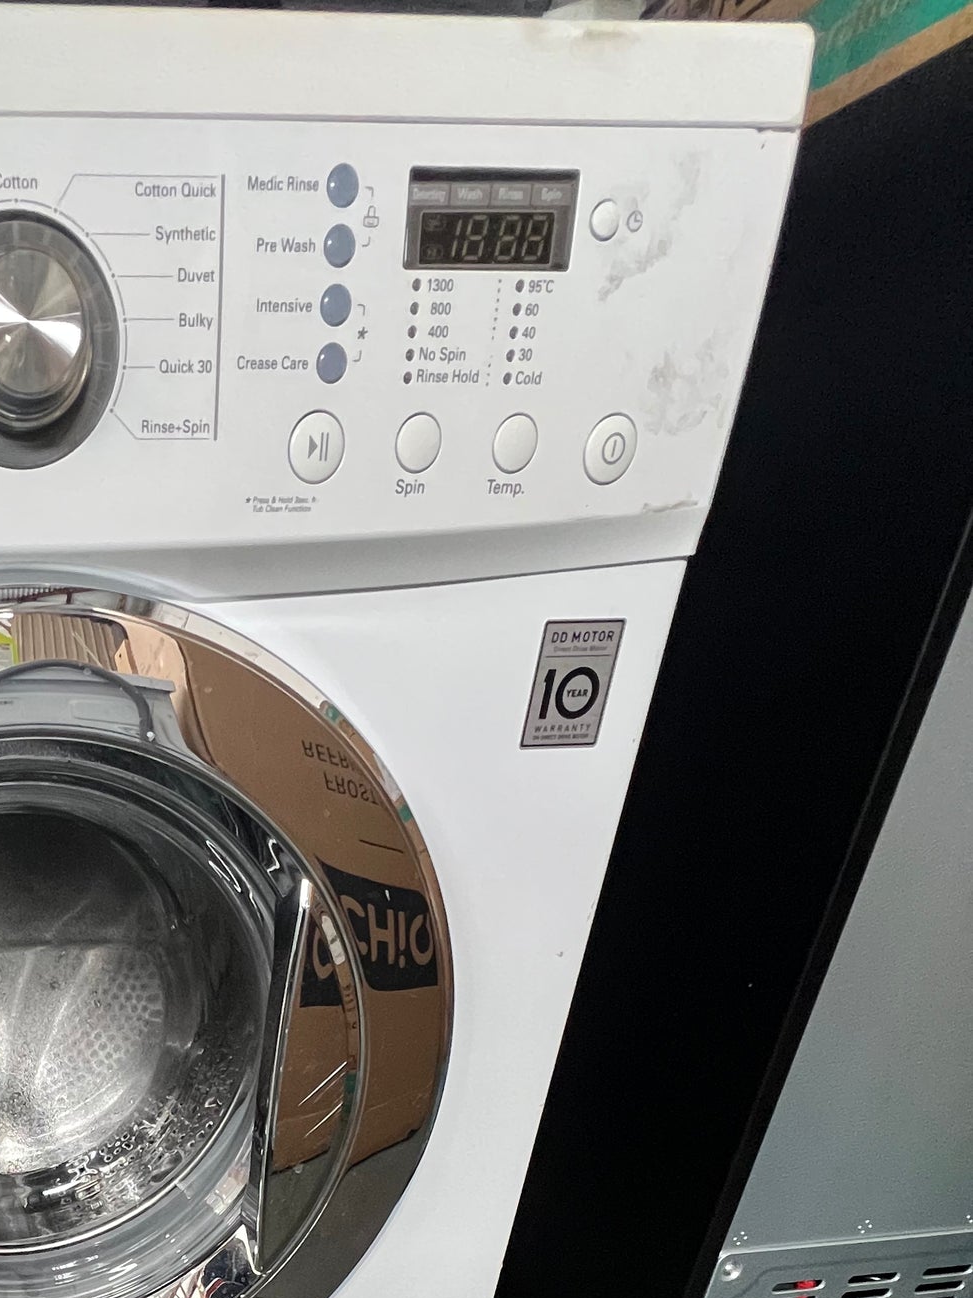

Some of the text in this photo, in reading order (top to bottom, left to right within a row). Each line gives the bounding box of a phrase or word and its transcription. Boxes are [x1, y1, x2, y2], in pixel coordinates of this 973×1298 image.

[135, 181, 216, 198] Cotton Quick
[247, 175, 319, 191] Medic Rinse
[155, 225, 216, 245] Synthetic
[256, 237, 316, 252] Pre Wash
[177, 267, 215, 282] Duvet
[427, 278, 454, 292] 1300
[528, 279, 554, 293] 95°C
[256, 298, 312, 313] Intensive
[430, 302, 452, 315] 800
[525, 303, 539, 316] 60
[178, 312, 214, 331] Bulky
[428, 325, 449, 338] 400
[521, 326, 536, 339] 40
[419, 347, 466, 364] No Spin
[518, 348, 533, 361] 30
[159, 359, 213, 374] Quick 30
[237, 356, 309, 370] Crease Care
[416, 369, 479, 383] Rinse Hold
[515, 371, 542, 385] Cold
[141, 419, 210, 437] Rinse+Spin
[395, 480, 425, 496] Spin
[488, 480, 525, 495] Temp.
[551, 630, 615, 643] DD MOTOR
[538, 666, 600, 720] 10
[566, 688, 589, 698] YEAR
[534, 723, 592, 734] WARRANTY
